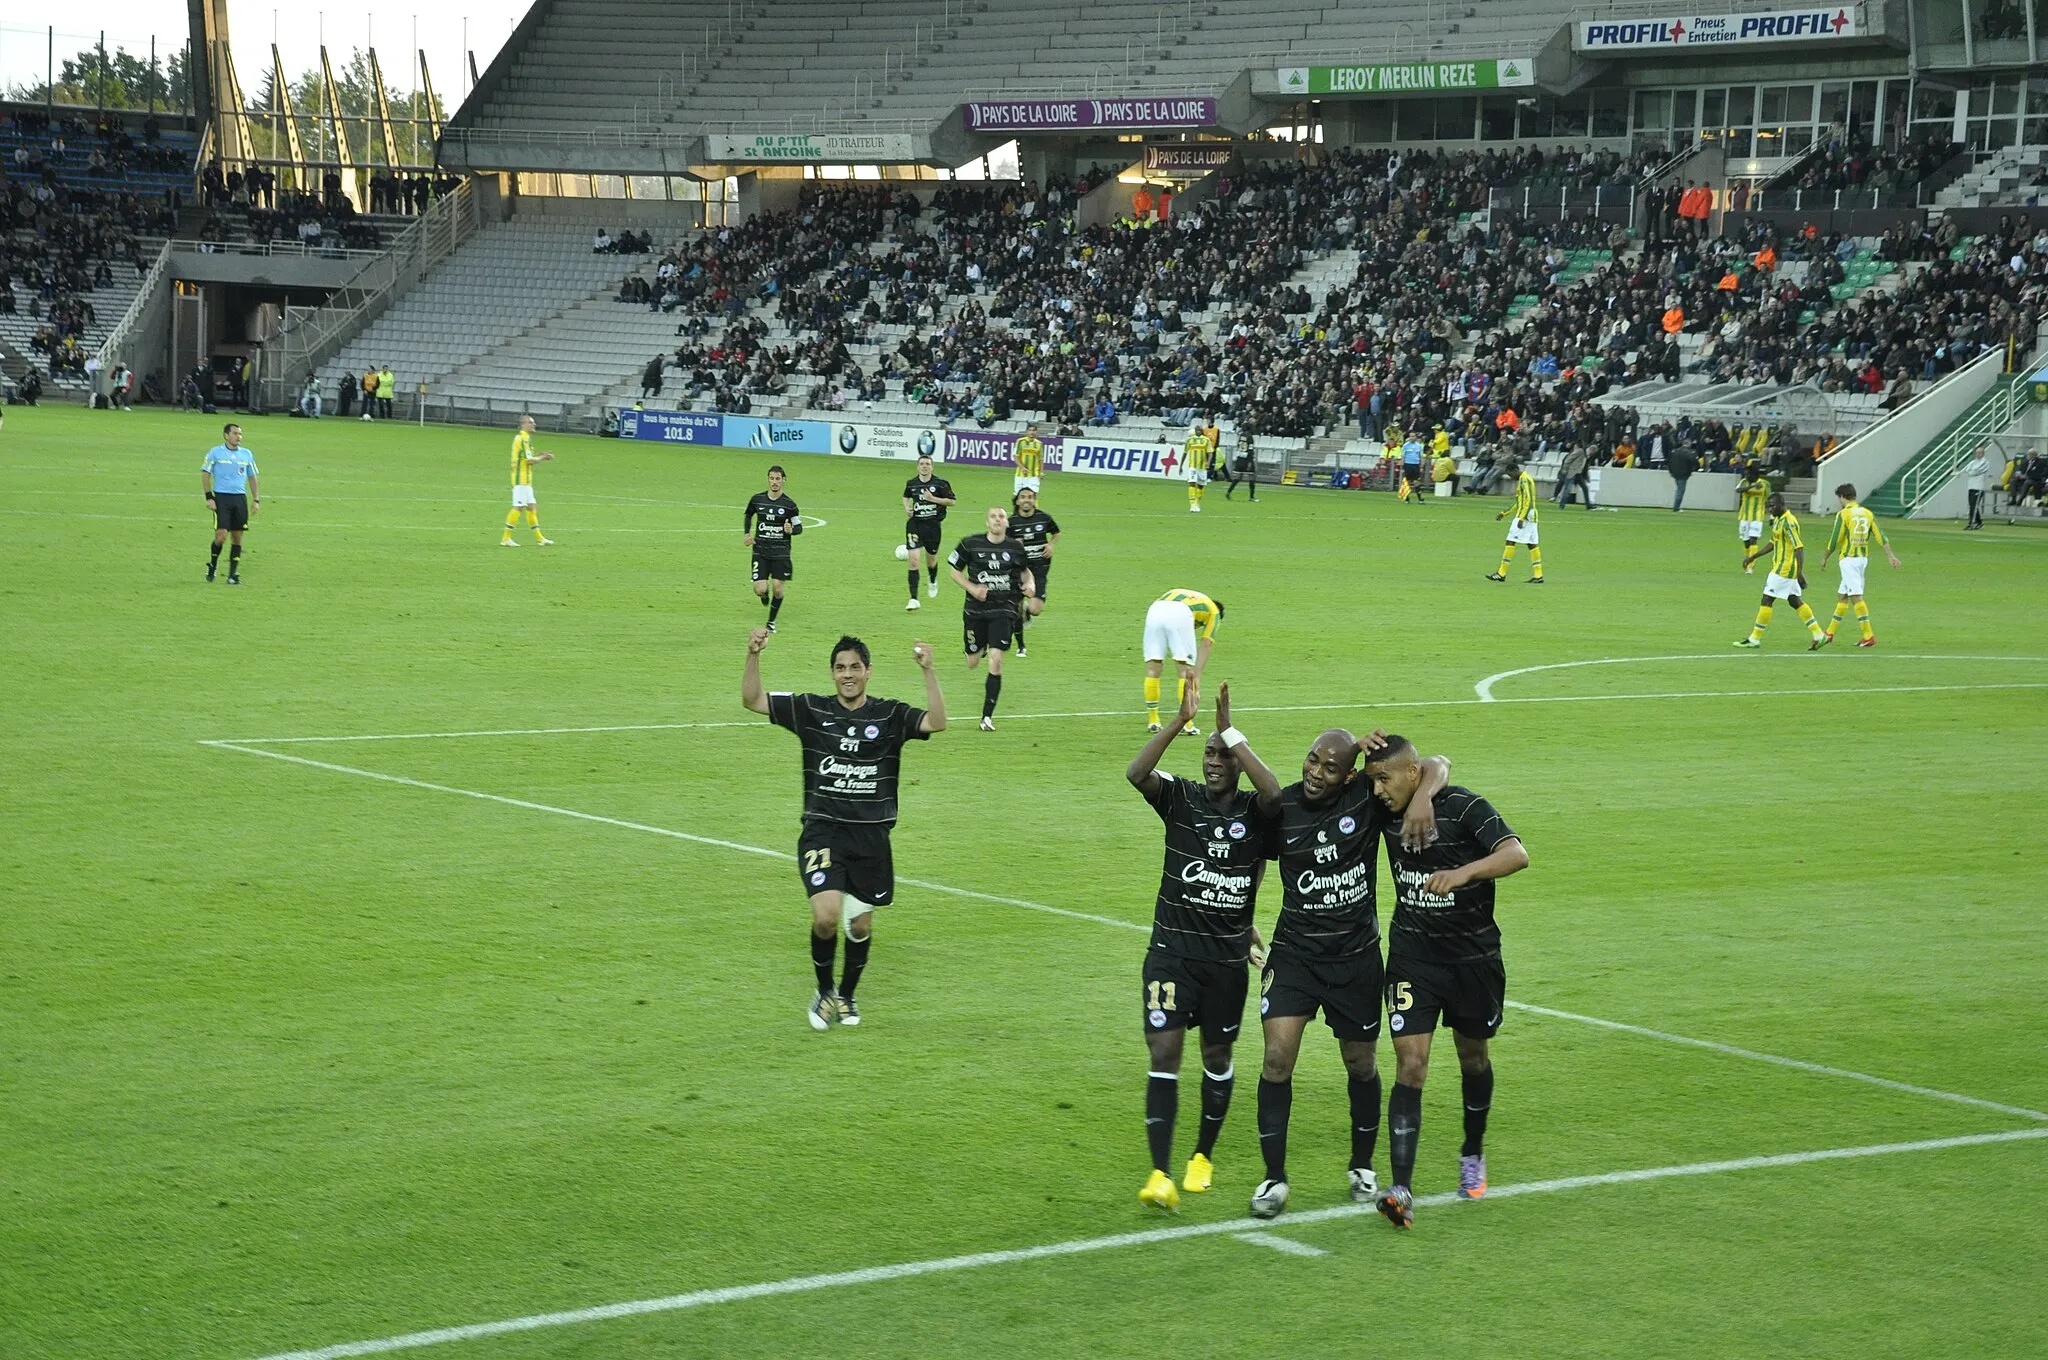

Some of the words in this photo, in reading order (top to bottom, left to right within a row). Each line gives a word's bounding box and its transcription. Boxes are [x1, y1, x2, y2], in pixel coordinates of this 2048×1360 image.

[1694, 17, 1726, 30] Pneus
[1688, 30, 1736, 43] Entretien
[1330, 67, 1376, 91] LEROY
[1378, 65, 1436, 90] MERLIN
[1439, 63, 1477, 88] REZE
[982, 105, 1009, 124] PAYS
[1012, 105, 1026, 123] DE
[1028, 105, 1042, 122] LA
[1045, 104, 1078, 122] LOIRE
[1104, 103, 1132, 121] PAYS
[1136, 102, 1151, 120] DE
[1153, 102, 1169, 120] LA
[1172, 101, 1206, 120] LOIRE
[755, 136, 773, 146] AU
[778, 135, 809, 146] P'TIT
[826, 137, 838, 148] JD
[839, 137, 885, 148] TRAITEUR
[744, 147, 758, 157] St
[763, 147, 822, 157] ANTOINE
[1158, 151, 1179, 164] PAYS
[1180, 151, 1192, 164] DE
[1193, 151, 1204, 164] LA
[1206, 151, 1230, 165] LOIRE
[643, 413, 658, 423] tous
[658, 414, 668, 424] les
[669, 415, 694, 426] matchs
[694, 416, 703, 427] du
[704, 417, 718, 428] FCN
[664, 426, 694, 441] 101.8
[756, 423, 804, 448] Nantes
[873, 427, 904, 437] Solutions
[866, 437, 909, 449] d'Entreprises
[880, 449, 896, 458] BMW
[960, 438, 990, 460] PAYS
[991, 440, 1009, 461] DE
[1043, 444, 1063, 465] IRE
[1851, 516, 1870, 535] 23
[752, 561, 759, 573] 2
[966, 629, 976, 644] 5
[840, 742, 859, 753] CTI
[818, 755, 879, 780] Campagne
[833, 778, 847, 788] de
[846, 780, 878, 789] France
[1207, 847, 1229, 859] CTI
[1316, 849, 1339, 864] CTI
[804, 848, 832, 874] 21
[1181, 860, 1252, 894] Campagne
[1296, 862, 1366, 895] Campagne
[1200, 888, 1216, 900] de
[1323, 892, 1337, 905] de
[1338, 880, 1368, 902] France
[1407, 888, 1417, 900] de
[1146, 980, 1177, 1012] 11
[1388, 981, 1414, 1014] 15
